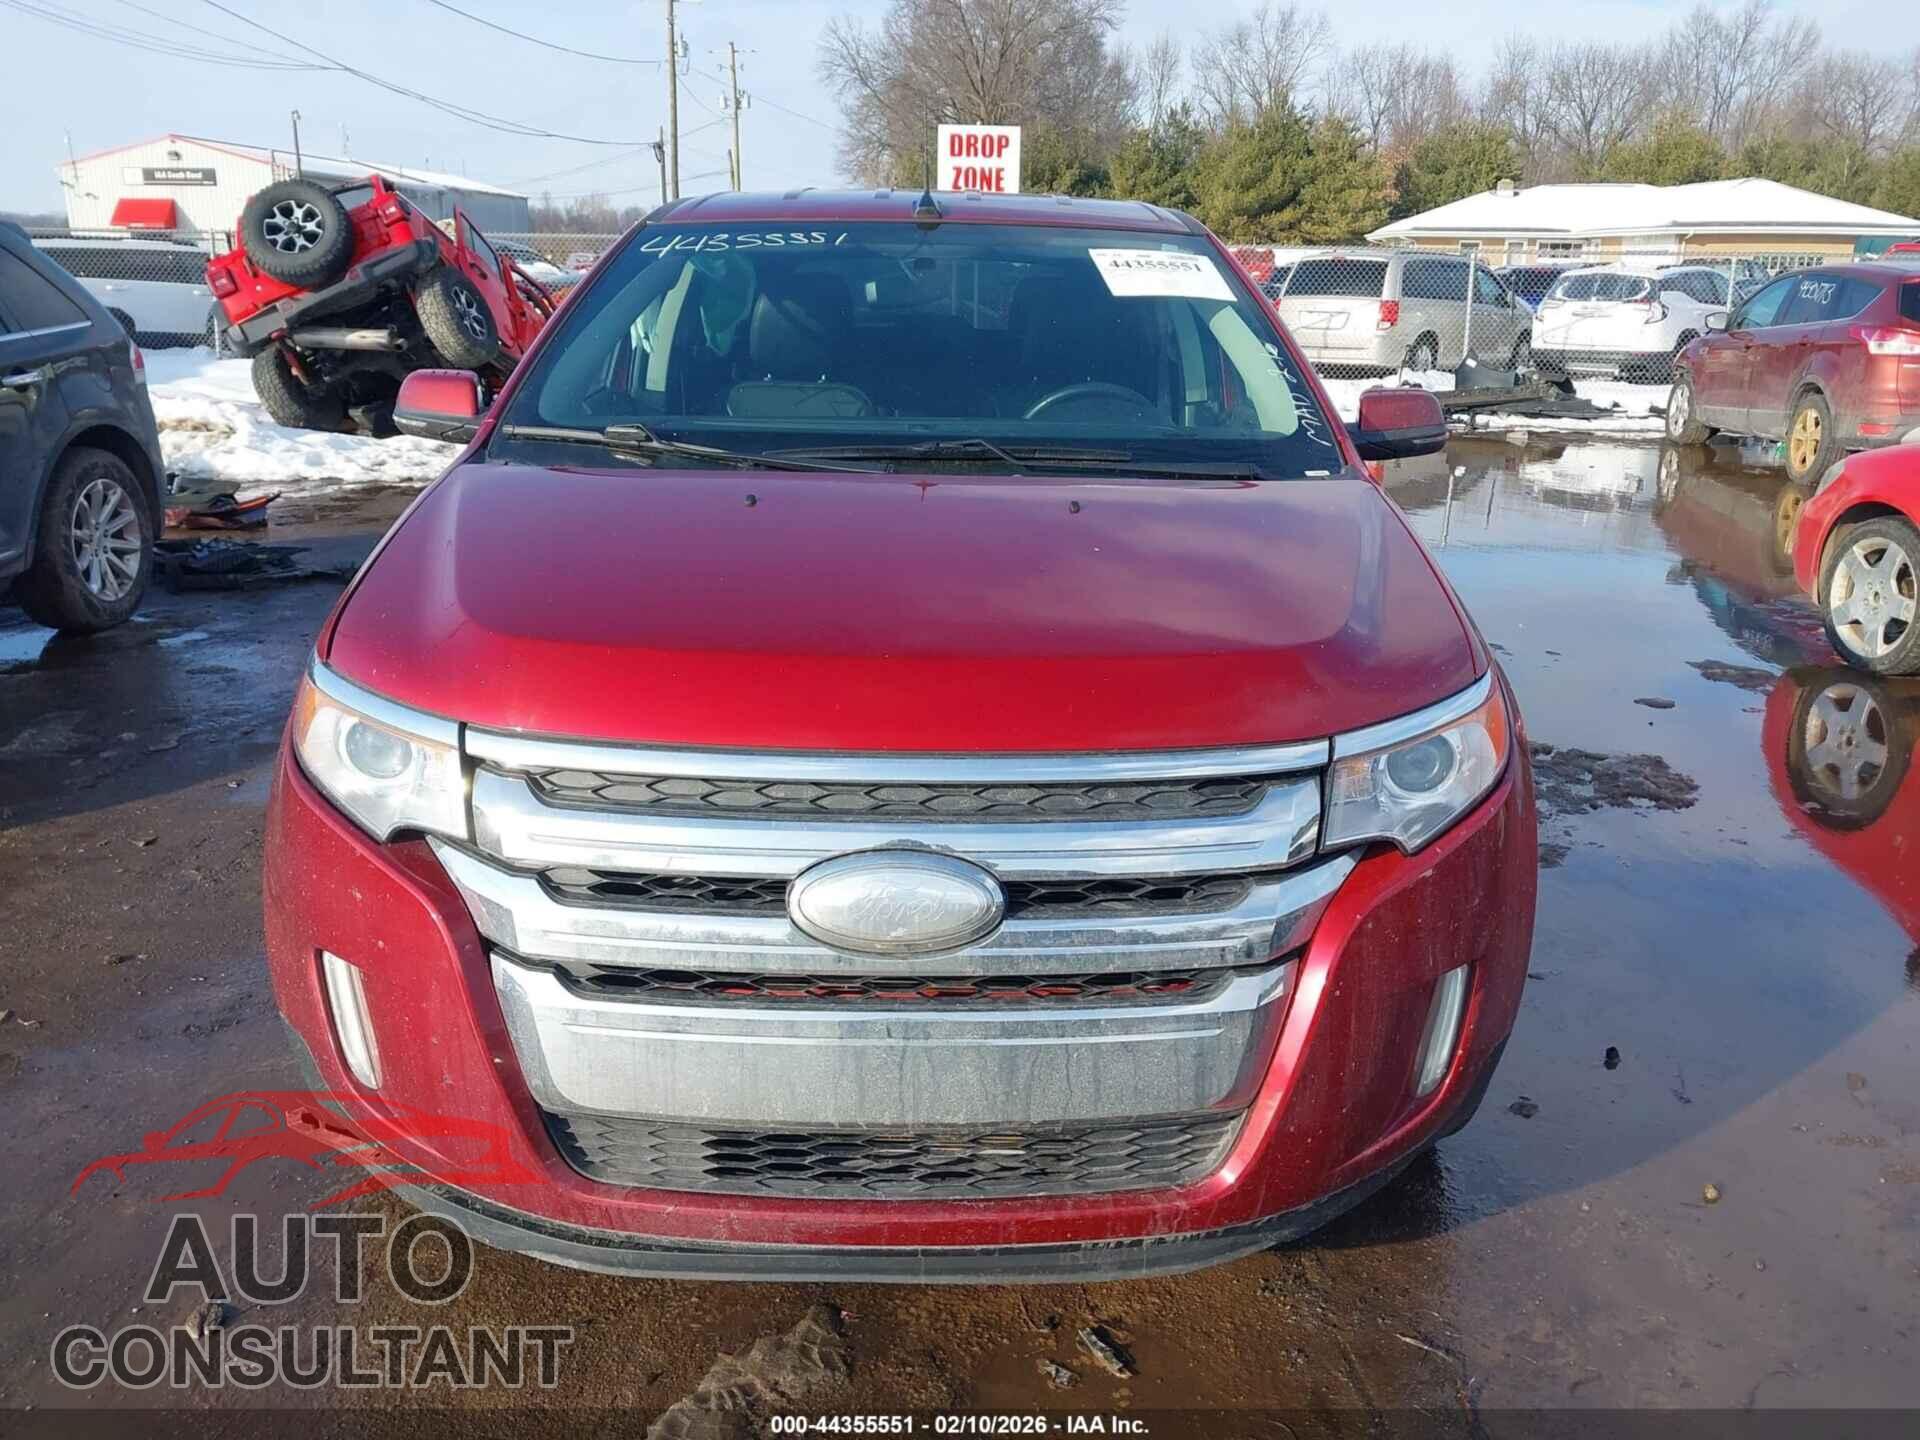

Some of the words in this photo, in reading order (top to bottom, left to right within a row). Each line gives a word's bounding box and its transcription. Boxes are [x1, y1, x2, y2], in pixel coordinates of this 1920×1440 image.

[949, 133, 1009, 158] DROP
[951, 166, 1005, 192] ZONE
[1109, 259, 1202, 273] 44355551
